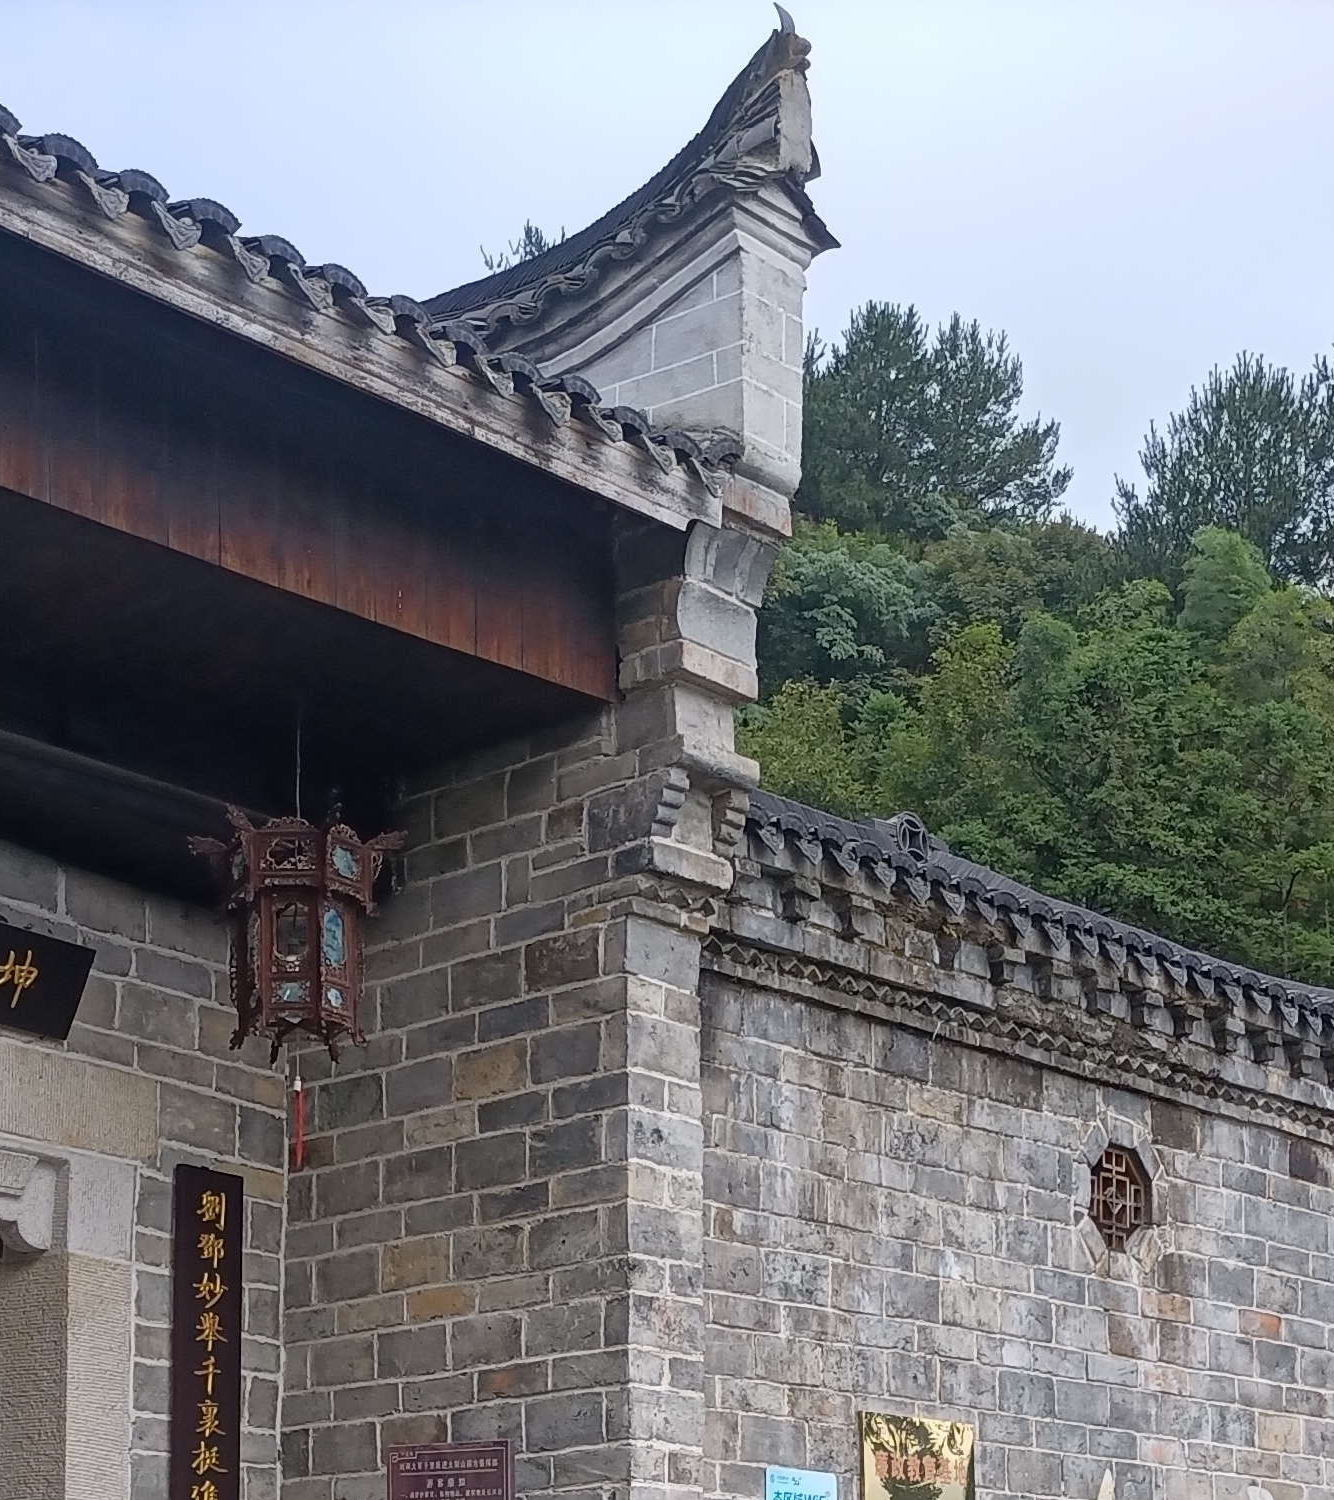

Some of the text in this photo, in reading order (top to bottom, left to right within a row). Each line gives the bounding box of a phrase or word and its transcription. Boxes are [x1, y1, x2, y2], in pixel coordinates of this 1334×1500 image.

[874, 1450, 968, 1488] 廉政教育基地
